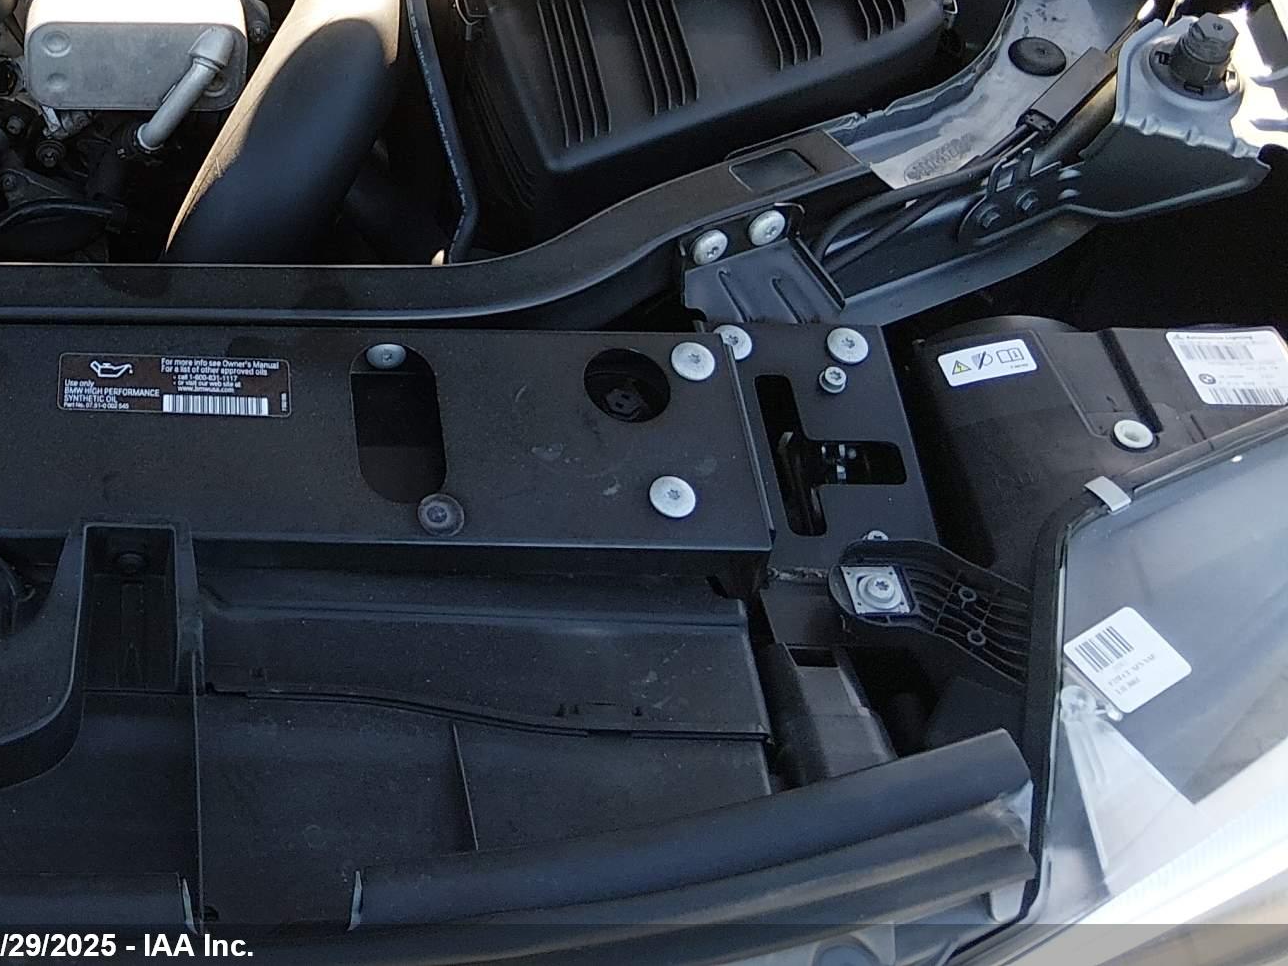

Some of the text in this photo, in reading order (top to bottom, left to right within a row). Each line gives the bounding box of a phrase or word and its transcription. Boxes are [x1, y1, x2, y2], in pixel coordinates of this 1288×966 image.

[223, 360, 251, 368] Owner's
[253, 361, 280, 369] Manual
[221, 368, 254, 376] approved
[255, 368, 268, 376] oils
[79, 379, 95, 388] only
[84, 387, 103, 395] HIGH
[104, 388, 160, 396] PERFORMANCE
[64, 394, 117, 403] SYNTHETIC OIL
